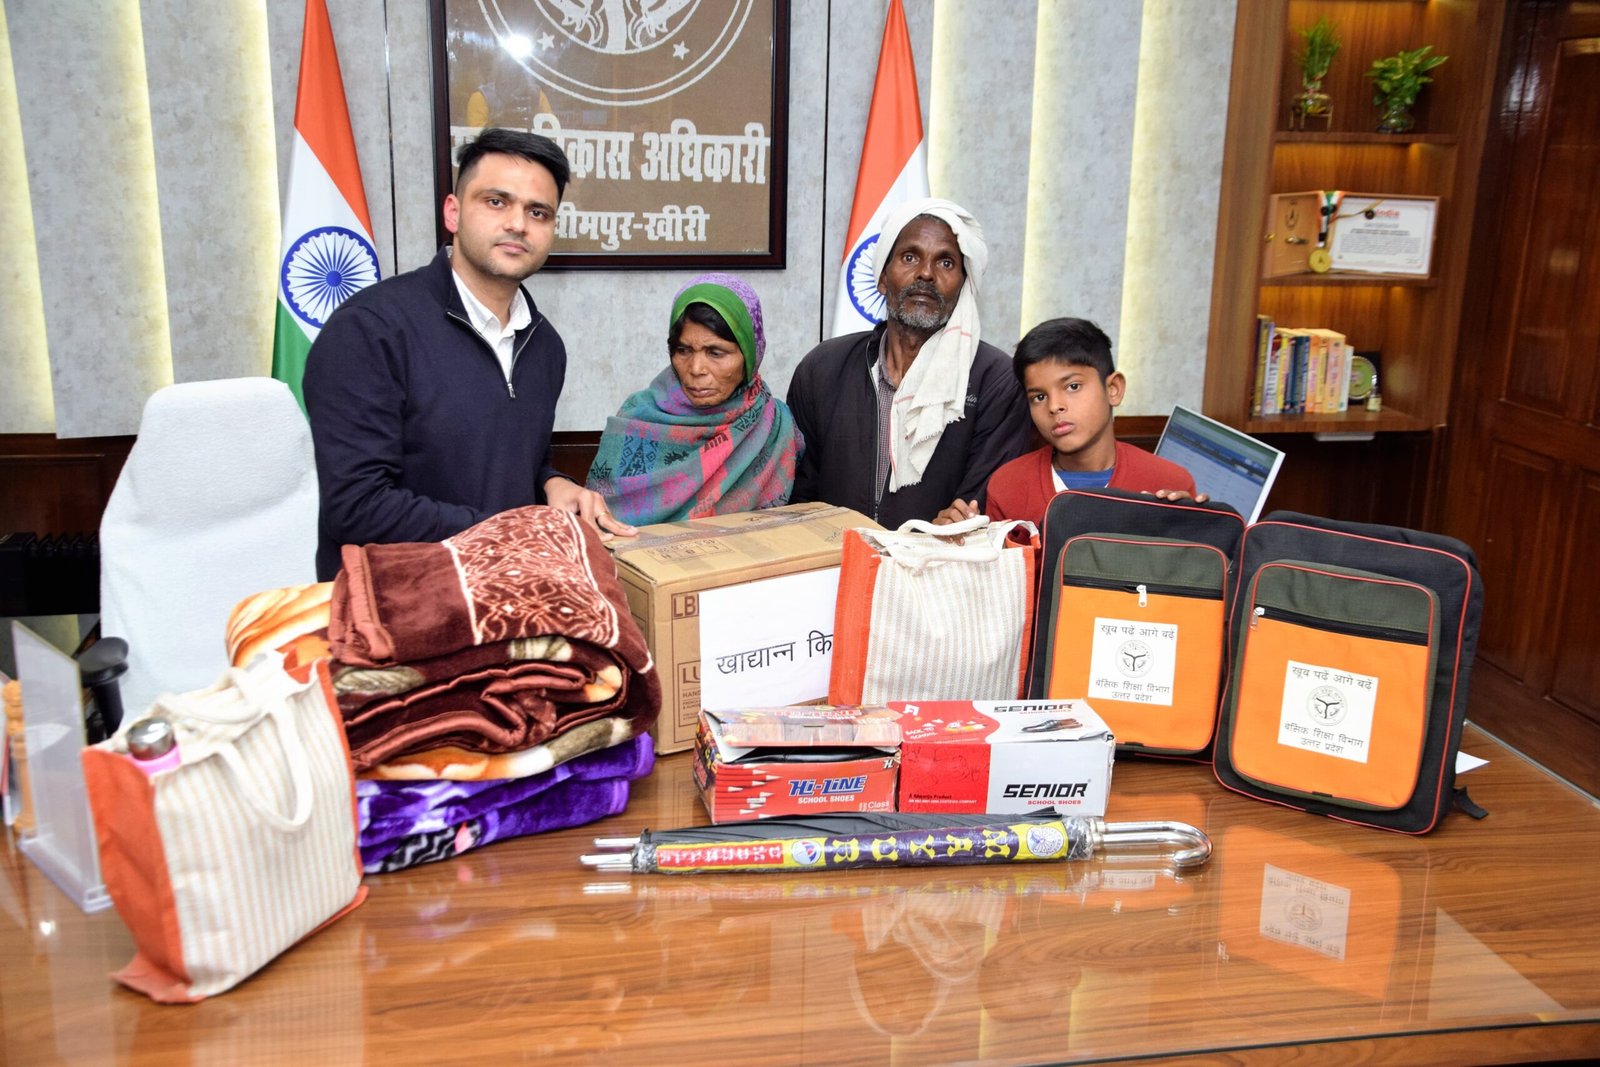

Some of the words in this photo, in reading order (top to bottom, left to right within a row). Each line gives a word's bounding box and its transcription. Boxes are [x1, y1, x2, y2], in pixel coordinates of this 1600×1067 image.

[641, 118, 770, 184] अधिकारी
[554, 202, 710, 250] ीमपुर-खीरी
[1139, 627, 1158, 637] आगे
[716, 641, 796, 674] खाद्यान्न
[1333, 673, 1354, 686] आगे
[1122, 680, 1142, 691] शिक्षा
[1147, 683, 1170, 694] विभाग
[1135, 693, 1152, 702] प्रदेश
[994, 703, 1073, 713] SENIOR
[1313, 727, 1334, 741] शिक्षा
[1338, 733, 1364, 748] विभाग
[1325, 742, 1344, 754] प्रदेश
[1003, 783, 1088, 798] SENIOR
[830, 795, 855, 803] SHOES
